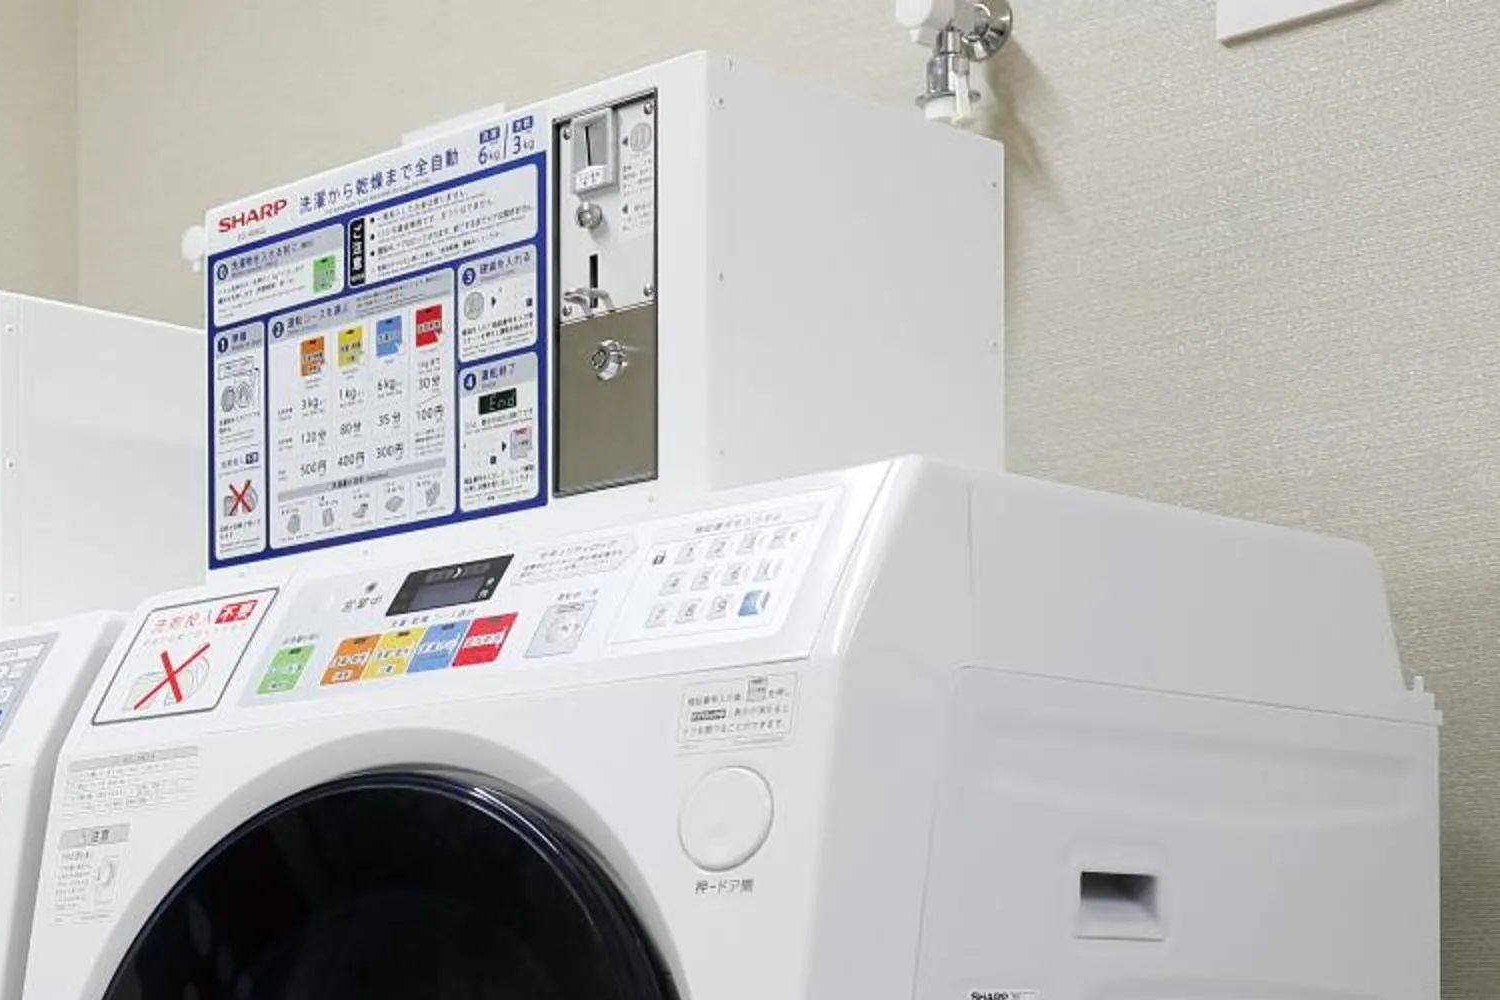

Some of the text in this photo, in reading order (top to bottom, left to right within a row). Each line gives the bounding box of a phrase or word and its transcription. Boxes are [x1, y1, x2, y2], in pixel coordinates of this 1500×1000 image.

[299, 147, 459, 213] 洗濯から乾燥まで全自動
[218, 199, 288, 232] SHARP
